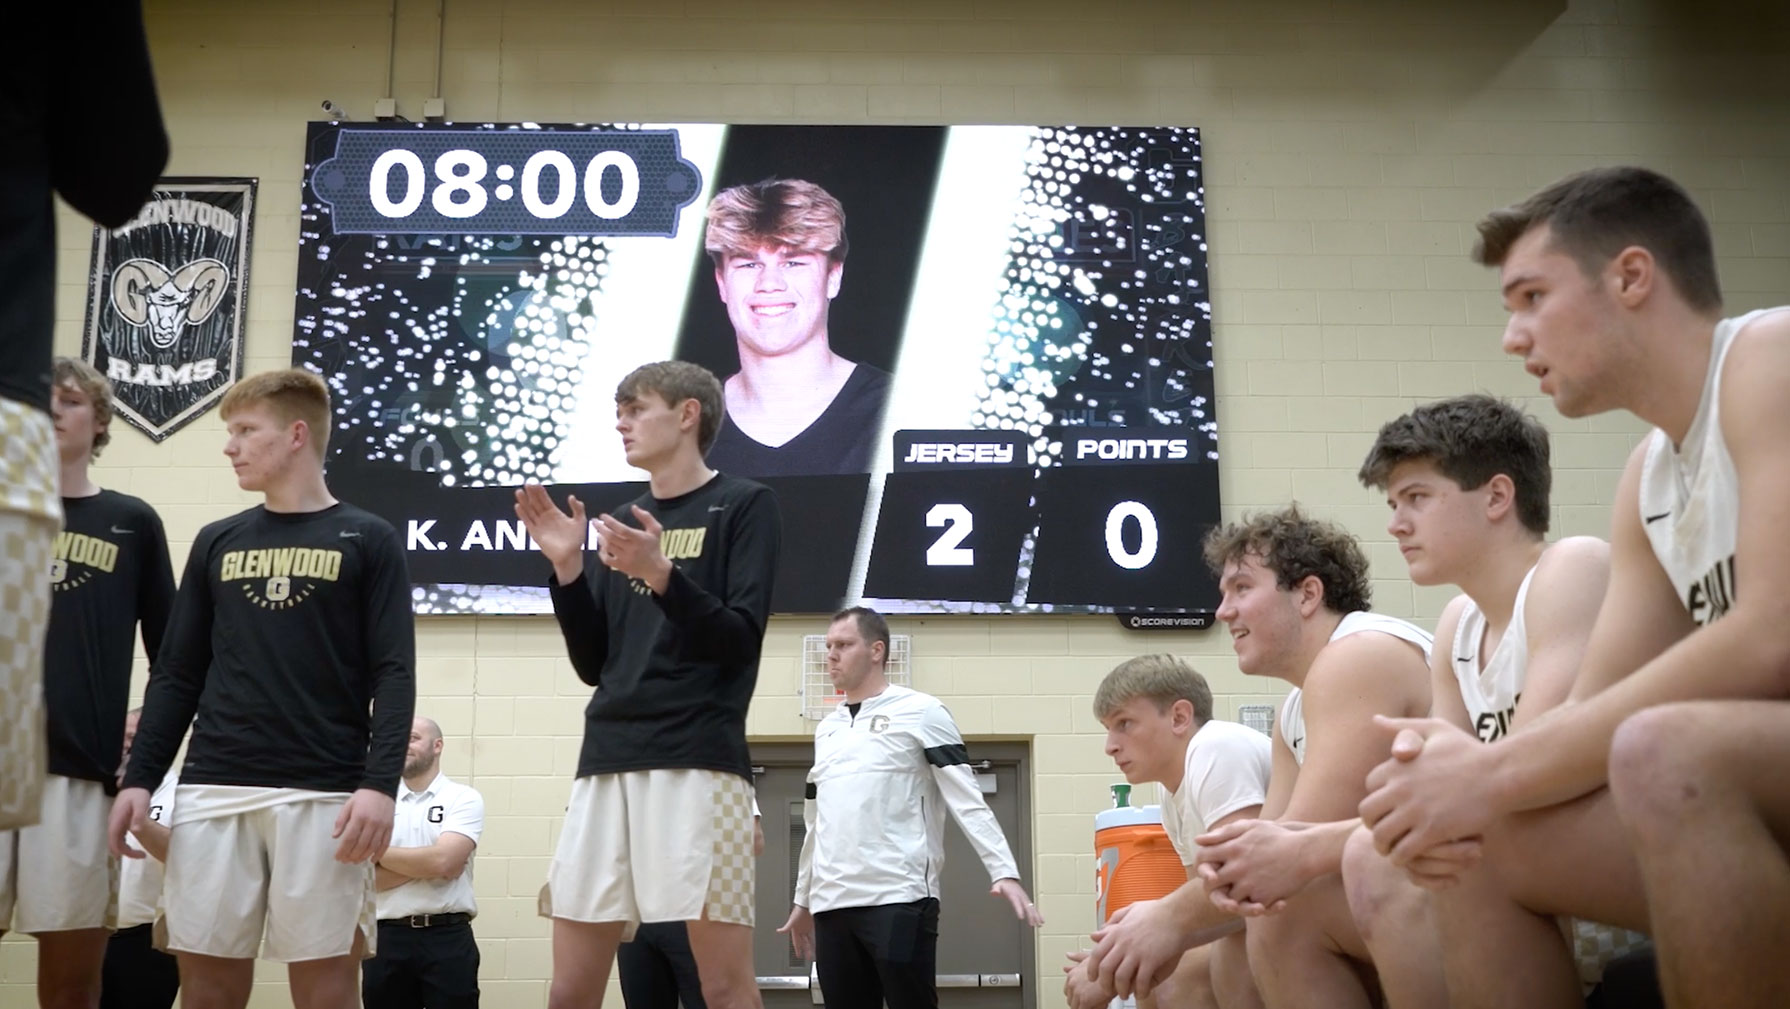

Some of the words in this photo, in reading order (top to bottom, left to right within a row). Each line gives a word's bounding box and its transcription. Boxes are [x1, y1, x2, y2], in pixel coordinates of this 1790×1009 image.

[370, 148, 640, 220] 08:00
[106, 356, 217, 386] RAMS
[904, 443, 1014, 463] JERSEY
[1077, 439, 1188, 460] POINTS
[406, 519, 448, 550] K.
[925, 503, 974, 566] 2
[1105, 500, 1159, 570] 0
[221, 547, 342, 582] GLENWOOD
[869, 714, 891, 734] G
[427, 805, 444, 823] G
